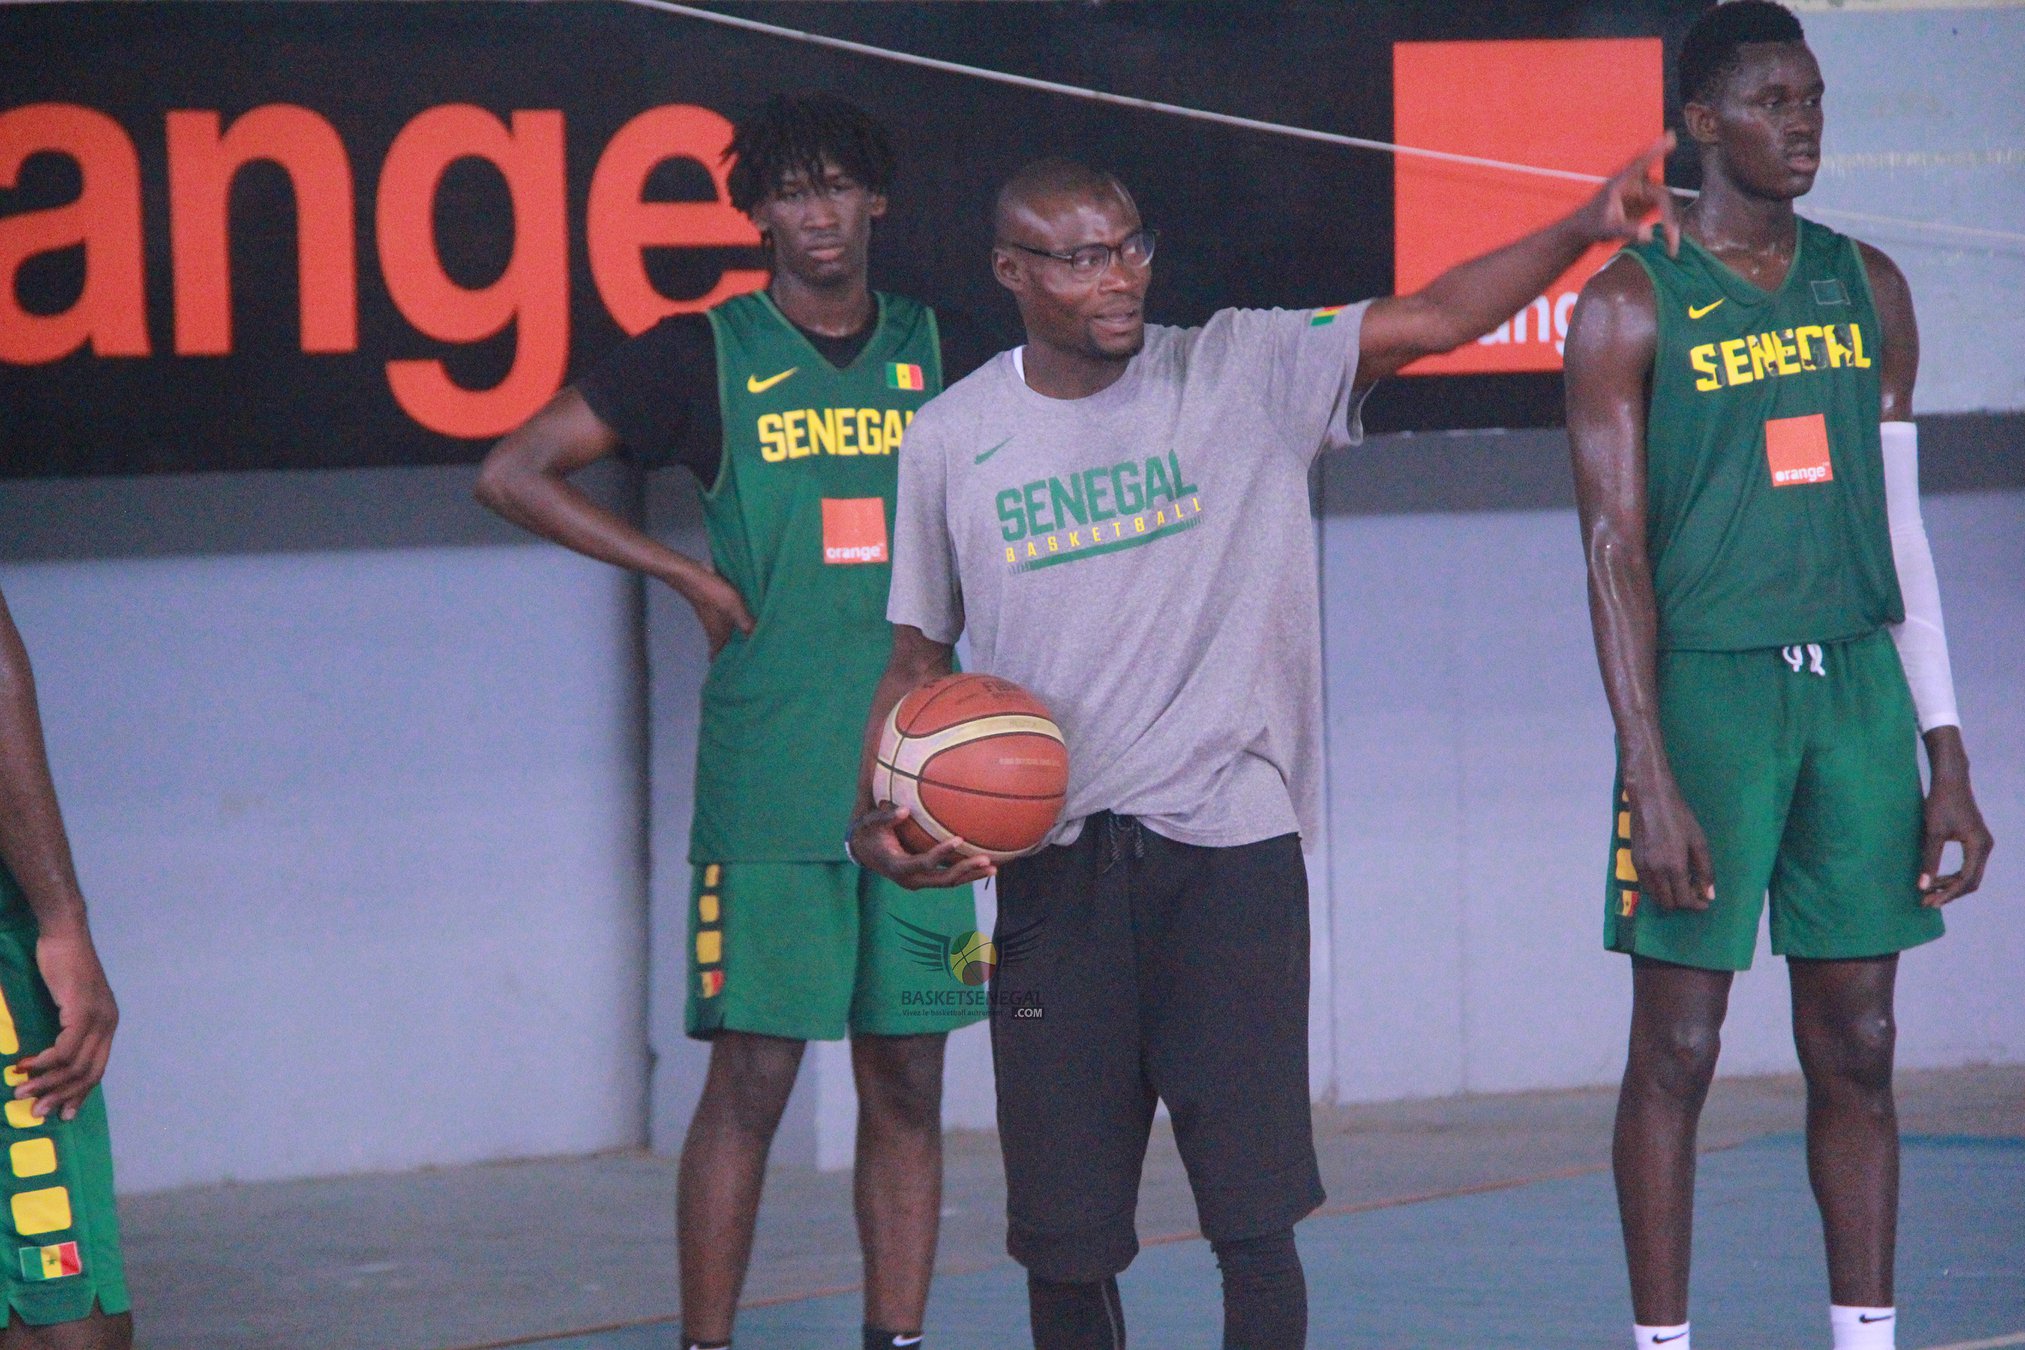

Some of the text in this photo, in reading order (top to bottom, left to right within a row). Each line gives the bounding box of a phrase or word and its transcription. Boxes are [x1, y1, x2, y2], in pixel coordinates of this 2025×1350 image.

[1775, 466, 1826, 482] orange
[995, 448, 1198, 542] SENEGAL
[1005, 497, 1202, 563] BASKETBALL
[826, 545, 881, 561] orange
